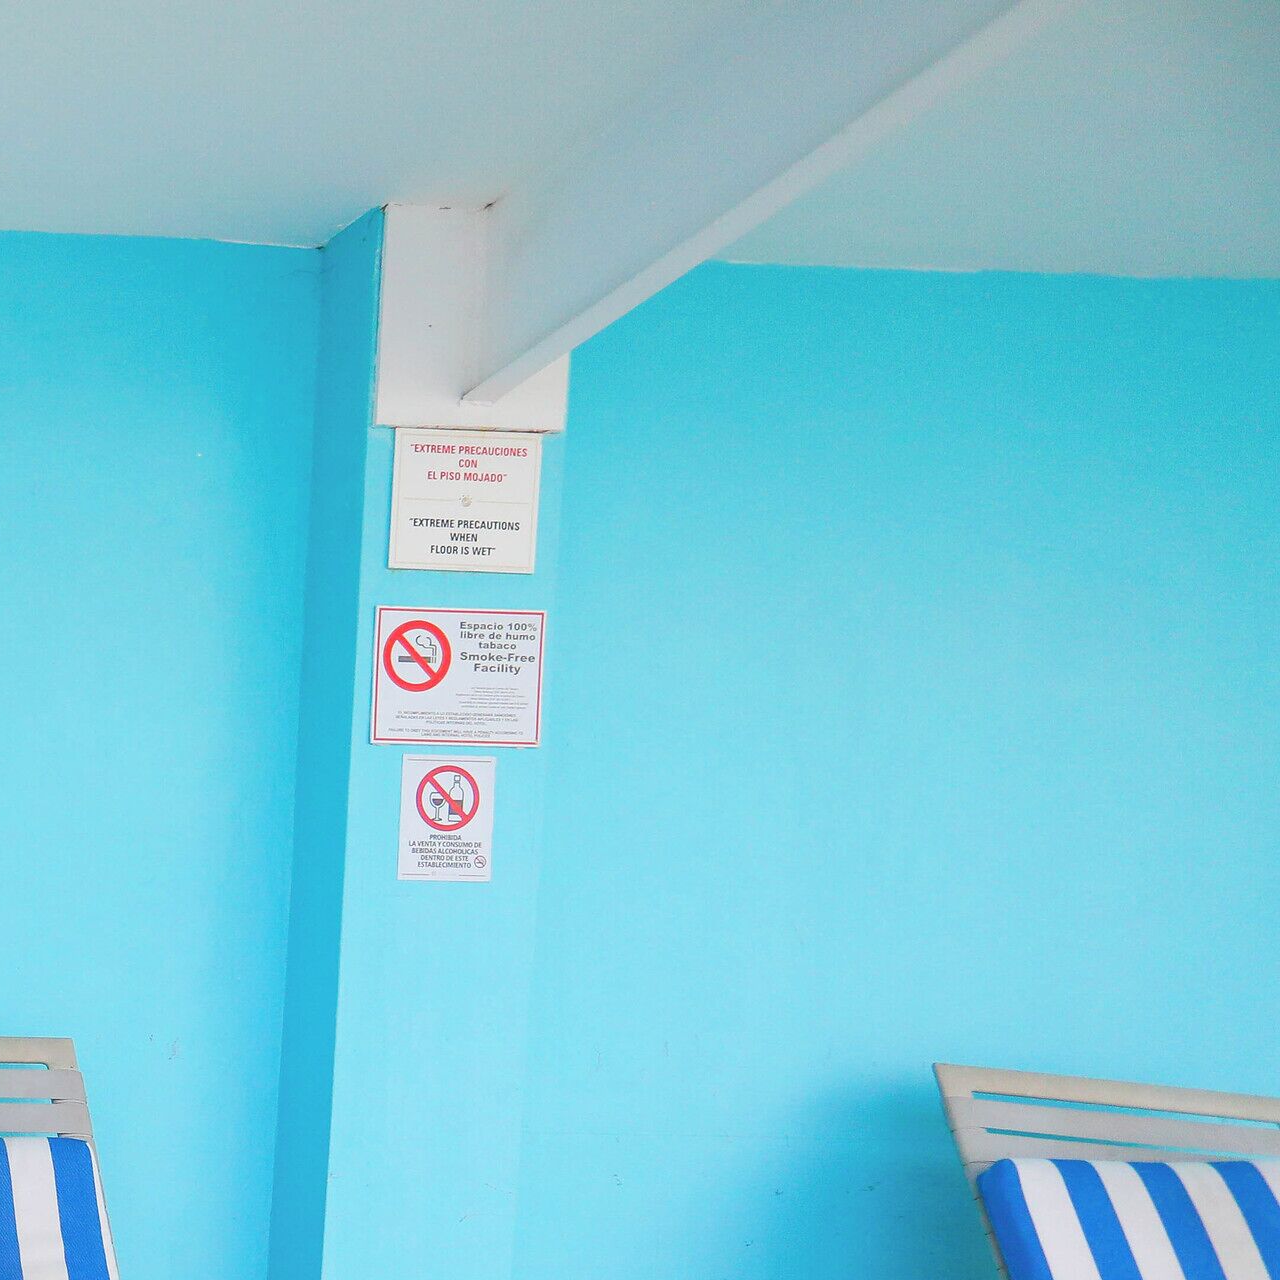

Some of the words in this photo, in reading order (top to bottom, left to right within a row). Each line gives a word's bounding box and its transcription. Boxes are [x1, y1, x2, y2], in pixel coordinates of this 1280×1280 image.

[458, 445, 527, 458] PRECAUCIONES
[458, 459, 477, 468] CON
[427, 470, 437, 480] EL
[440, 471, 461, 481] PISO
[457, 519, 520, 531] PRECAUTIONS
[450, 533, 477, 542] WHEN
[430, 544, 458, 555] FLOOR
[461, 545, 470, 555] IS
[460, 622, 504, 633] Espacio
[507, 622, 537, 632] 100%
[460, 631, 485, 640] libre
[488, 632, 502, 640] de
[505, 632, 536, 642] humo
[478, 642, 516, 650] tabaco
[460, 652, 536, 662] Smoke-Free
[474, 663, 520, 675] Facility
